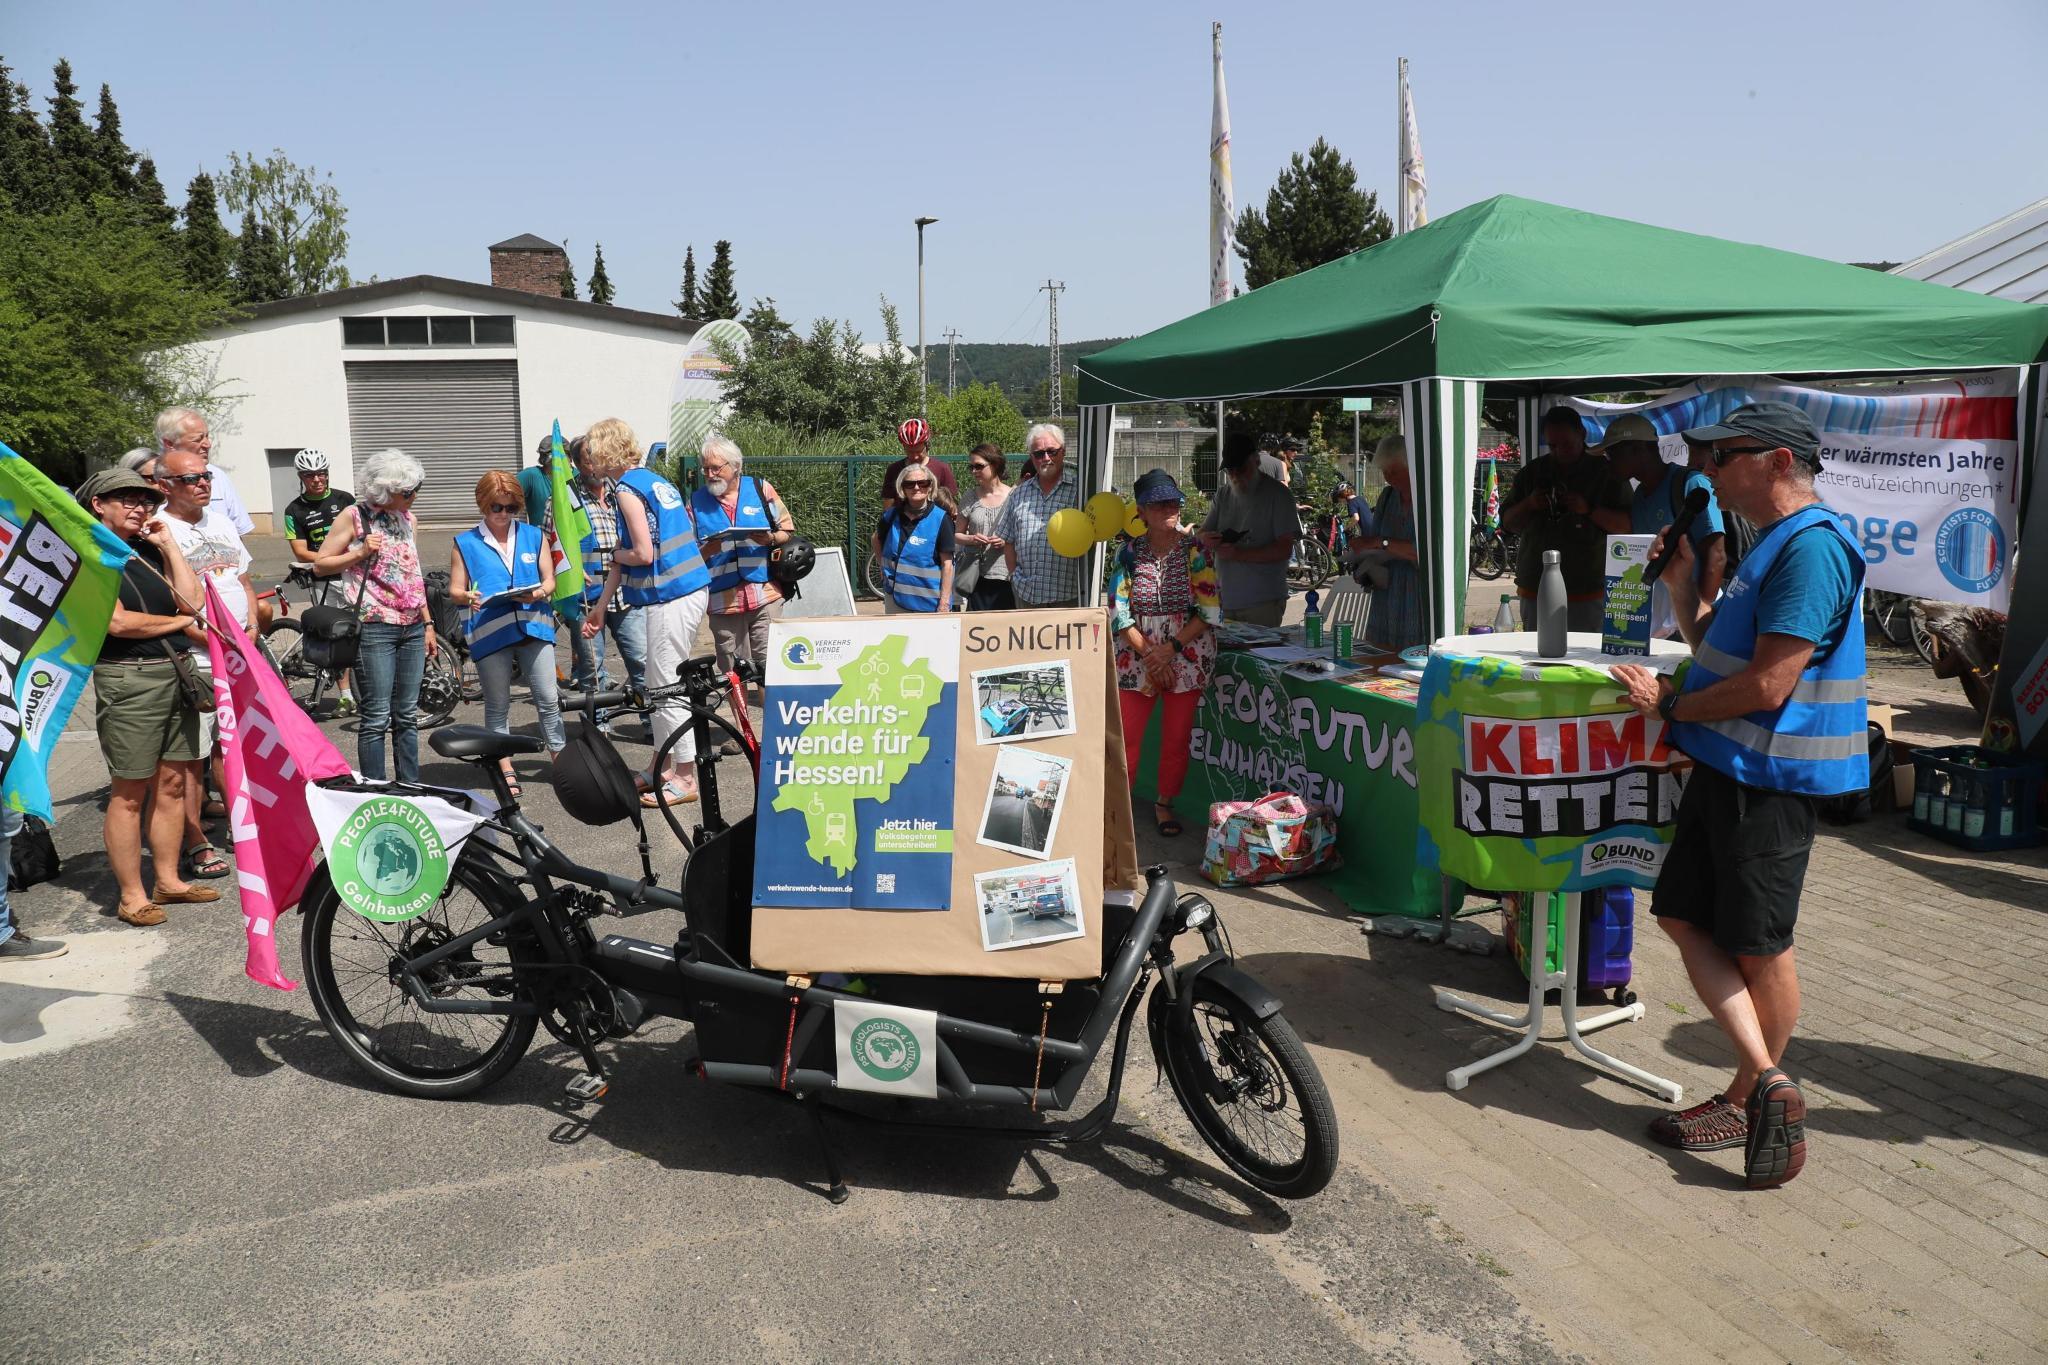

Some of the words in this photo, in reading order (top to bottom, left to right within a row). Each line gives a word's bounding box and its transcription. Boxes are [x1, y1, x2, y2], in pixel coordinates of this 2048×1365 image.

[1820, 446, 1840, 460] er
[1845, 446, 1941, 468] wärmsten
[1947, 450, 2005, 472] Jahre
[1817, 471, 2004, 501] etteraufzeichnungen
[1970, 511, 1993, 527] FOR
[1937, 511, 1968, 564] SCIENTISTS
[1606, 580, 1623, 589] Zeit
[1624, 580, 1637, 590] für
[1638, 581, 1651, 592] die
[1976, 560, 2003, 591] FUTURE
[1605, 600, 1632, 611] wende
[1606, 590, 1646, 601] Verkehrs-
[1605, 610, 1612, 619] in
[1613, 611, 1648, 622] Hessen!
[815, 639, 851, 647] VERKEHRS
[816, 646, 841, 654] WENDE
[965, 625, 1001, 653] So
[778, 698, 909, 725] Verkehrs-
[775, 730, 864, 756] wende
[873, 730, 914, 756] für
[1215, 675, 1282, 737] FOR
[1291, 697, 1418, 789] FUTUR
[774, 760, 885, 786] Hessen!
[1190, 728, 1344, 817] ELNHAUSEN
[1460, 768, 1693, 833] RETTEN
[339, 801, 443, 860] PEOPLE4FUTURE
[879, 819, 911, 832] Jetzt
[913, 818, 938, 831] hier
[879, 832, 937, 842] Volksbegehren
[878, 840, 937, 850] unterschreiben!
[1608, 844, 1655, 862] BUND
[343, 881, 432, 916] Gelnhausen
[767, 884, 854, 894] verkehrswende-hessen.de
[855, 1022, 902, 1068] PSYCHOLOGISTS
[901, 1041, 916, 1073] FUTURE
